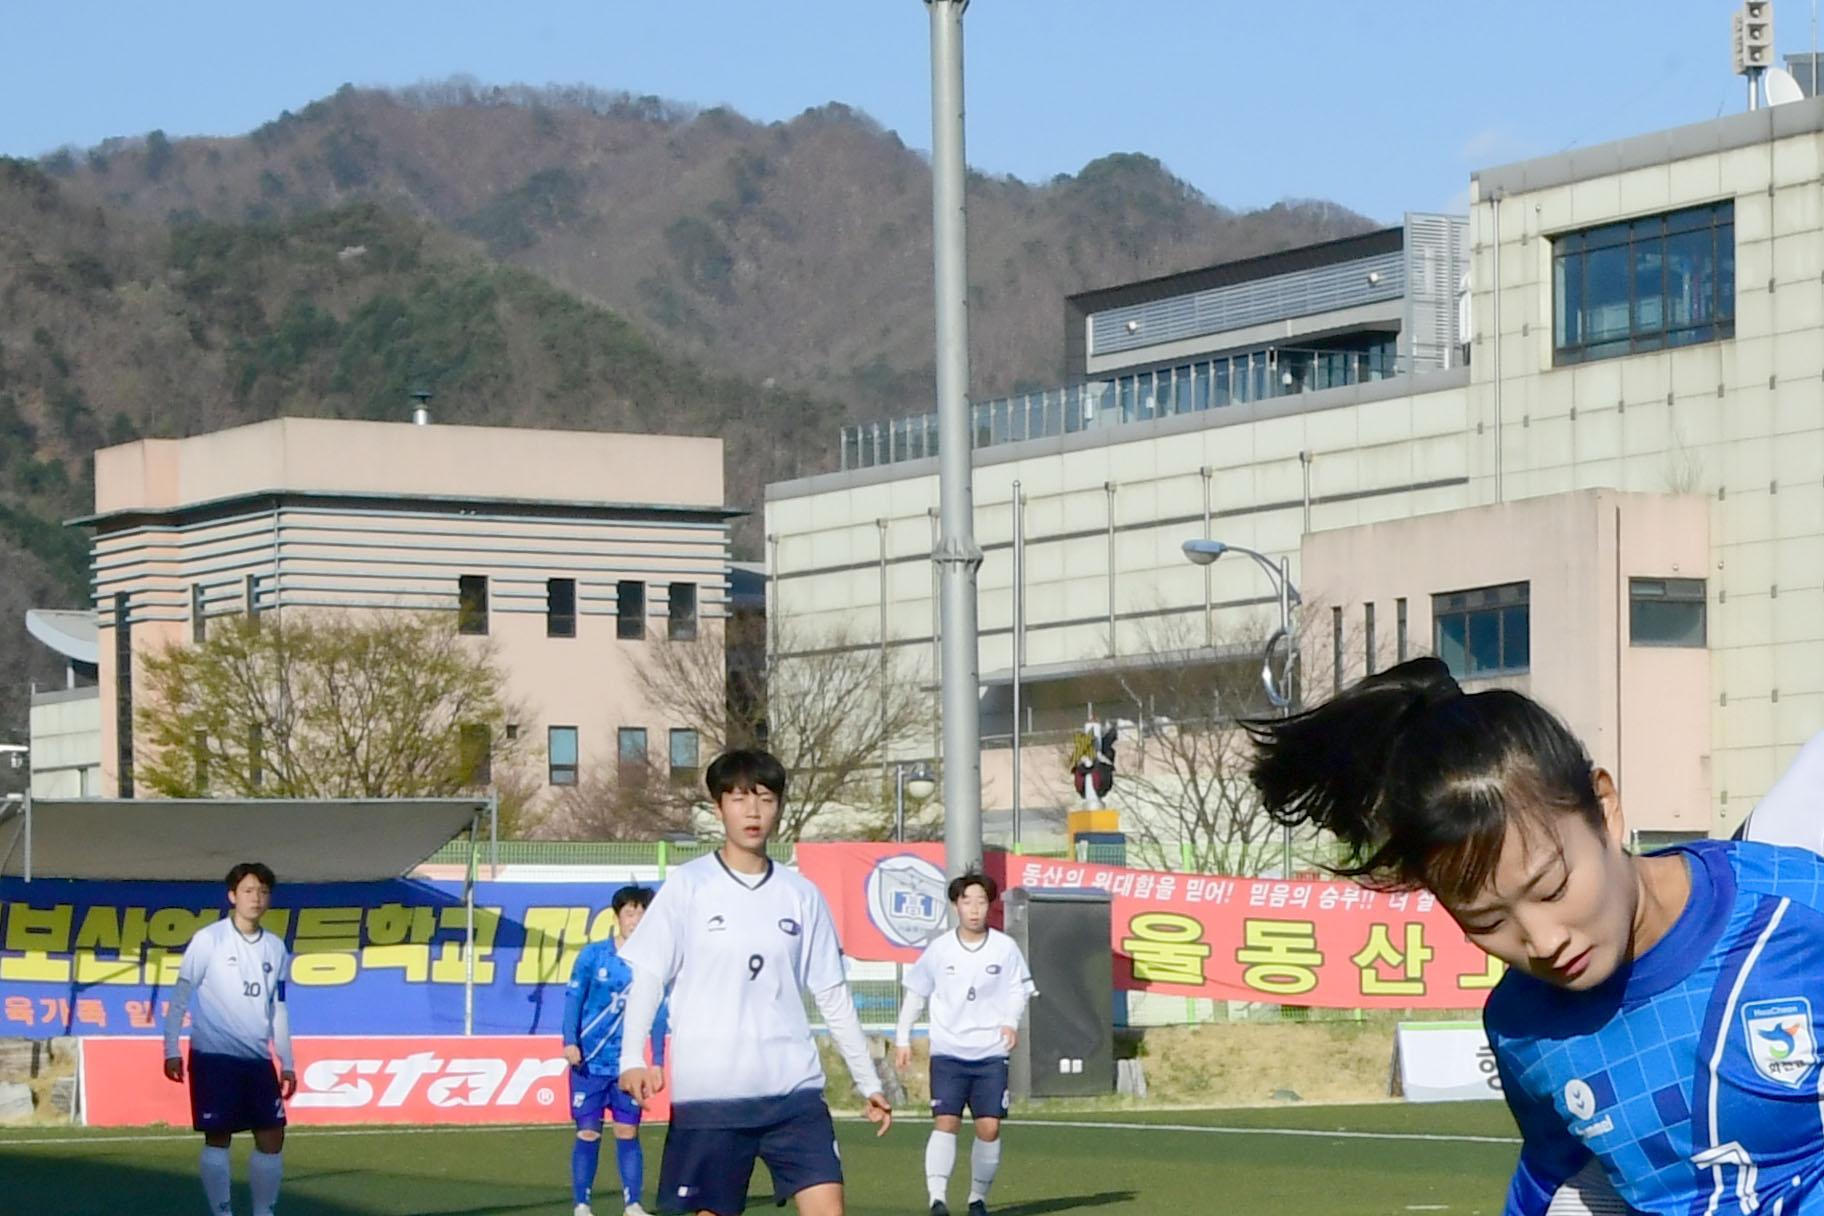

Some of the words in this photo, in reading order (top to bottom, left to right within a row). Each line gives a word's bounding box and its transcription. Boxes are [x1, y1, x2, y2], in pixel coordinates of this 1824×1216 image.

[1185, 878, 1234, 904] 믿어!
[1248, 883, 1312, 908] 믿음의
[1319, 887, 1376, 910] 승부!!
[0, 902, 502, 987] 보산업등학교
[748, 953, 764, 981] 9
[243, 980, 261, 998] 20
[966, 986, 977, 1002] 8
[290, 1052, 570, 1107] star
